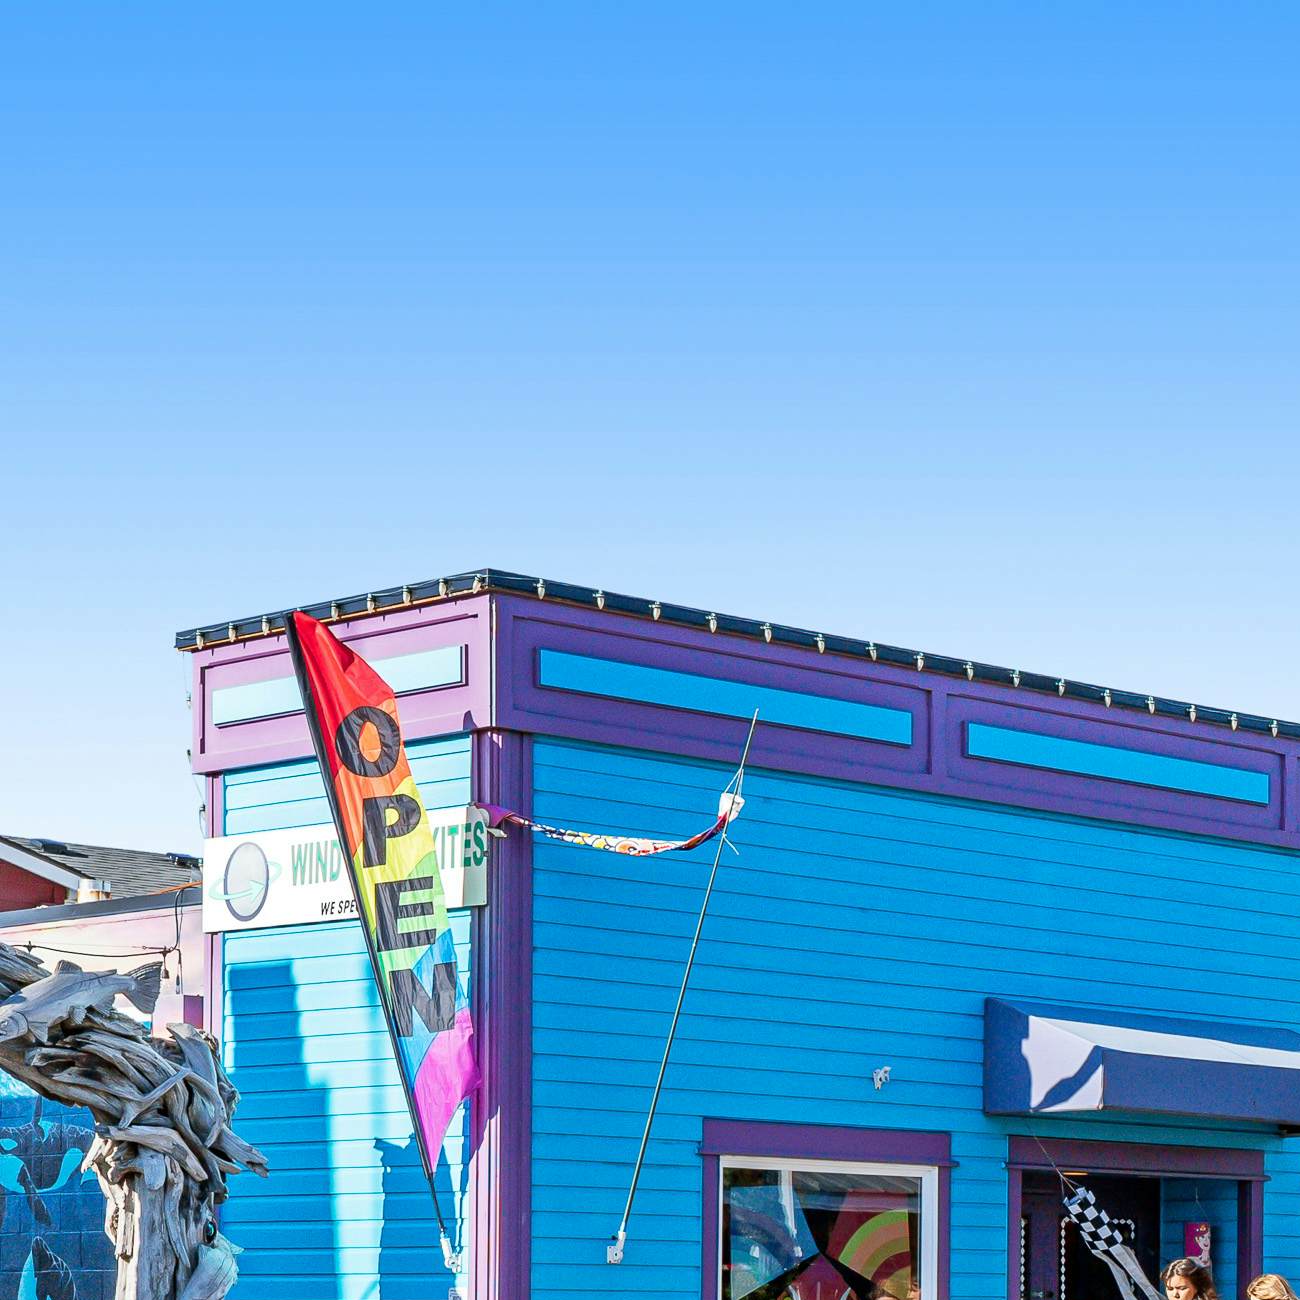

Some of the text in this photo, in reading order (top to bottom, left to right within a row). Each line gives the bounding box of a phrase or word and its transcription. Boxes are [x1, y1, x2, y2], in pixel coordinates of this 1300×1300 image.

[291, 839, 342, 886] WIND
[335, 705, 458, 1037] OPEN
[321, 902, 335, 916] WE
